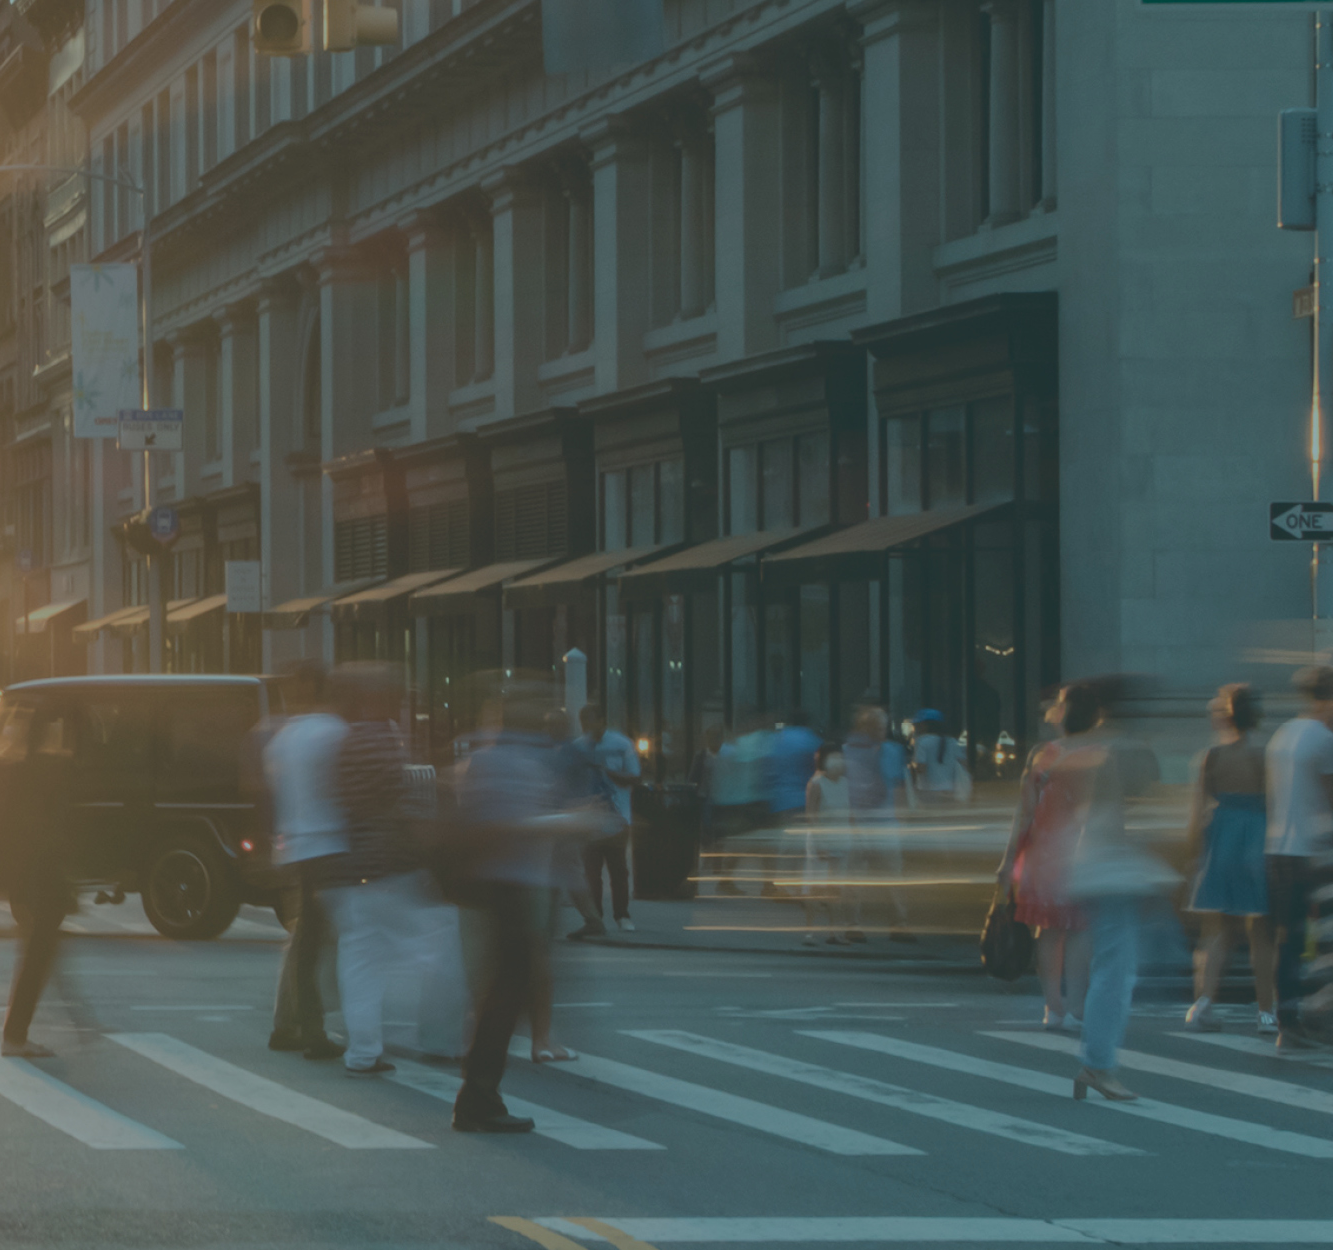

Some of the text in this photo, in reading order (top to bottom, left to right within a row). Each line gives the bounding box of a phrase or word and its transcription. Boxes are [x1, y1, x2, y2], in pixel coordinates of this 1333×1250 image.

[123, 422, 180, 431] BUSES ONLY
[1286, 513, 1323, 529] ONE
